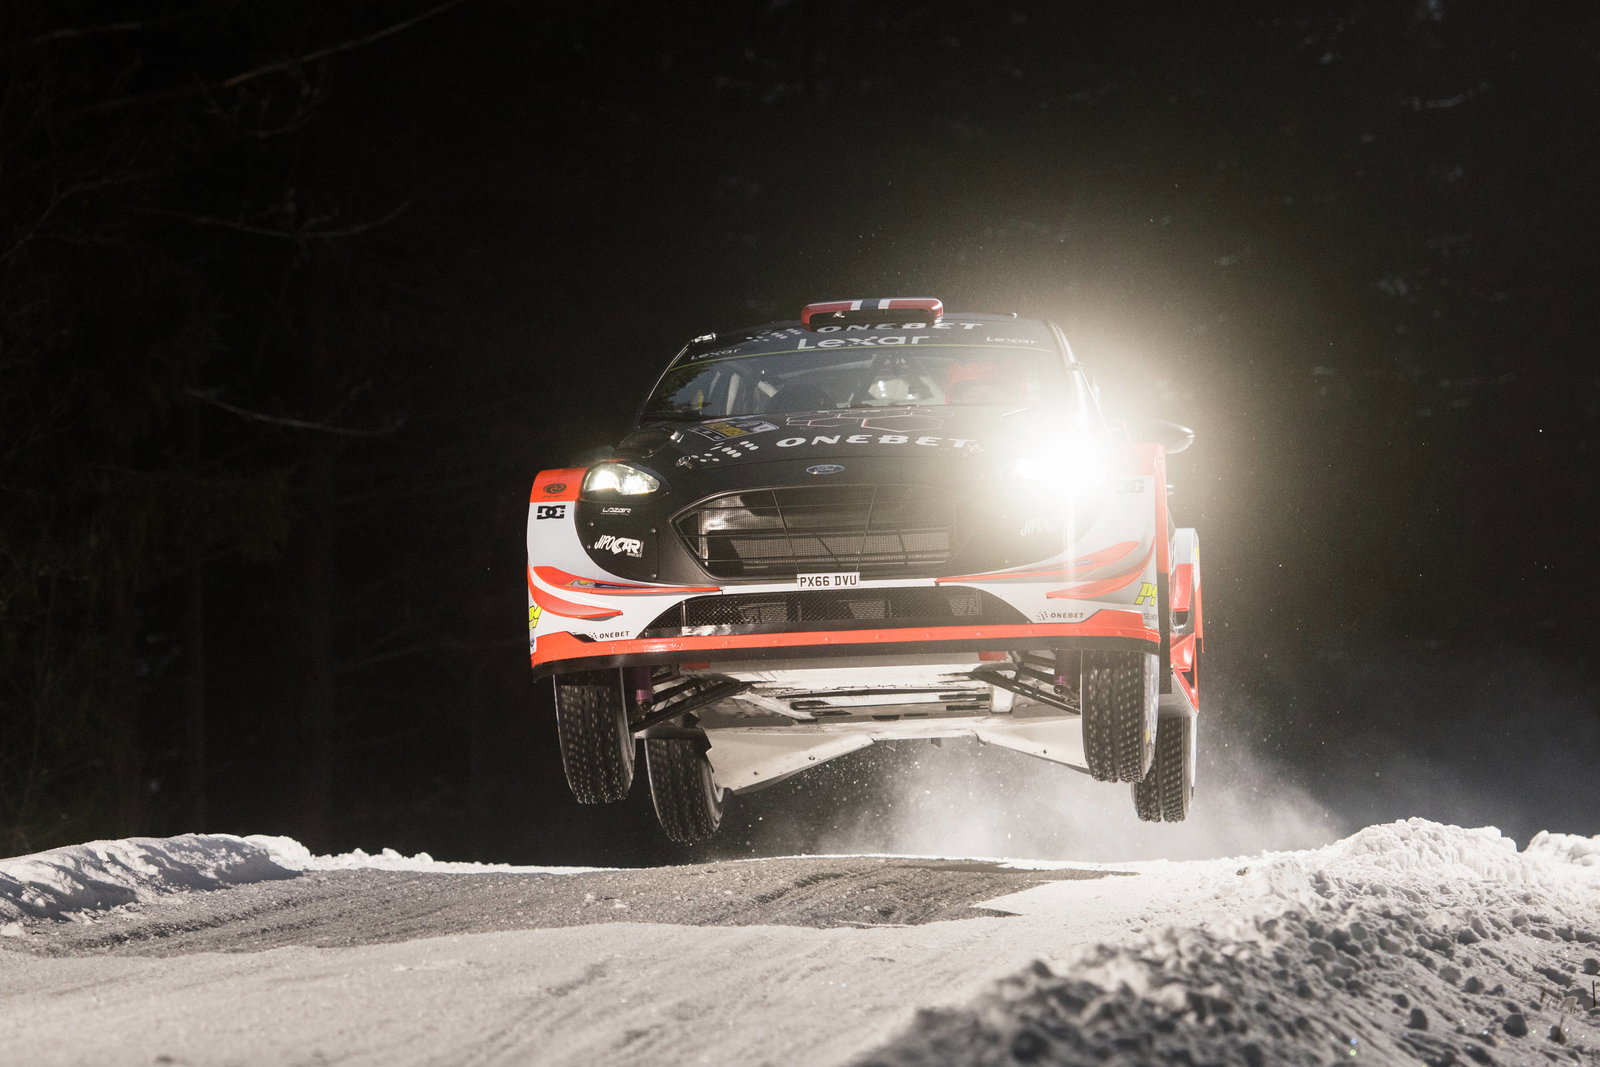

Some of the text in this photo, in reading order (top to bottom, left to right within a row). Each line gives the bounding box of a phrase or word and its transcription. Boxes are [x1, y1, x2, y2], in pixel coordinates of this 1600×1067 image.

[816, 322, 983, 333] ONEBET
[797, 335, 930, 350] Lexar
[986, 336, 1037, 344] Lexar
[690, 347, 739, 360] Lexar
[776, 434, 979, 448] ONEBET
[800, 575, 856, 587] PX66 DVU
[599, 630, 630, 639] ONEBET
